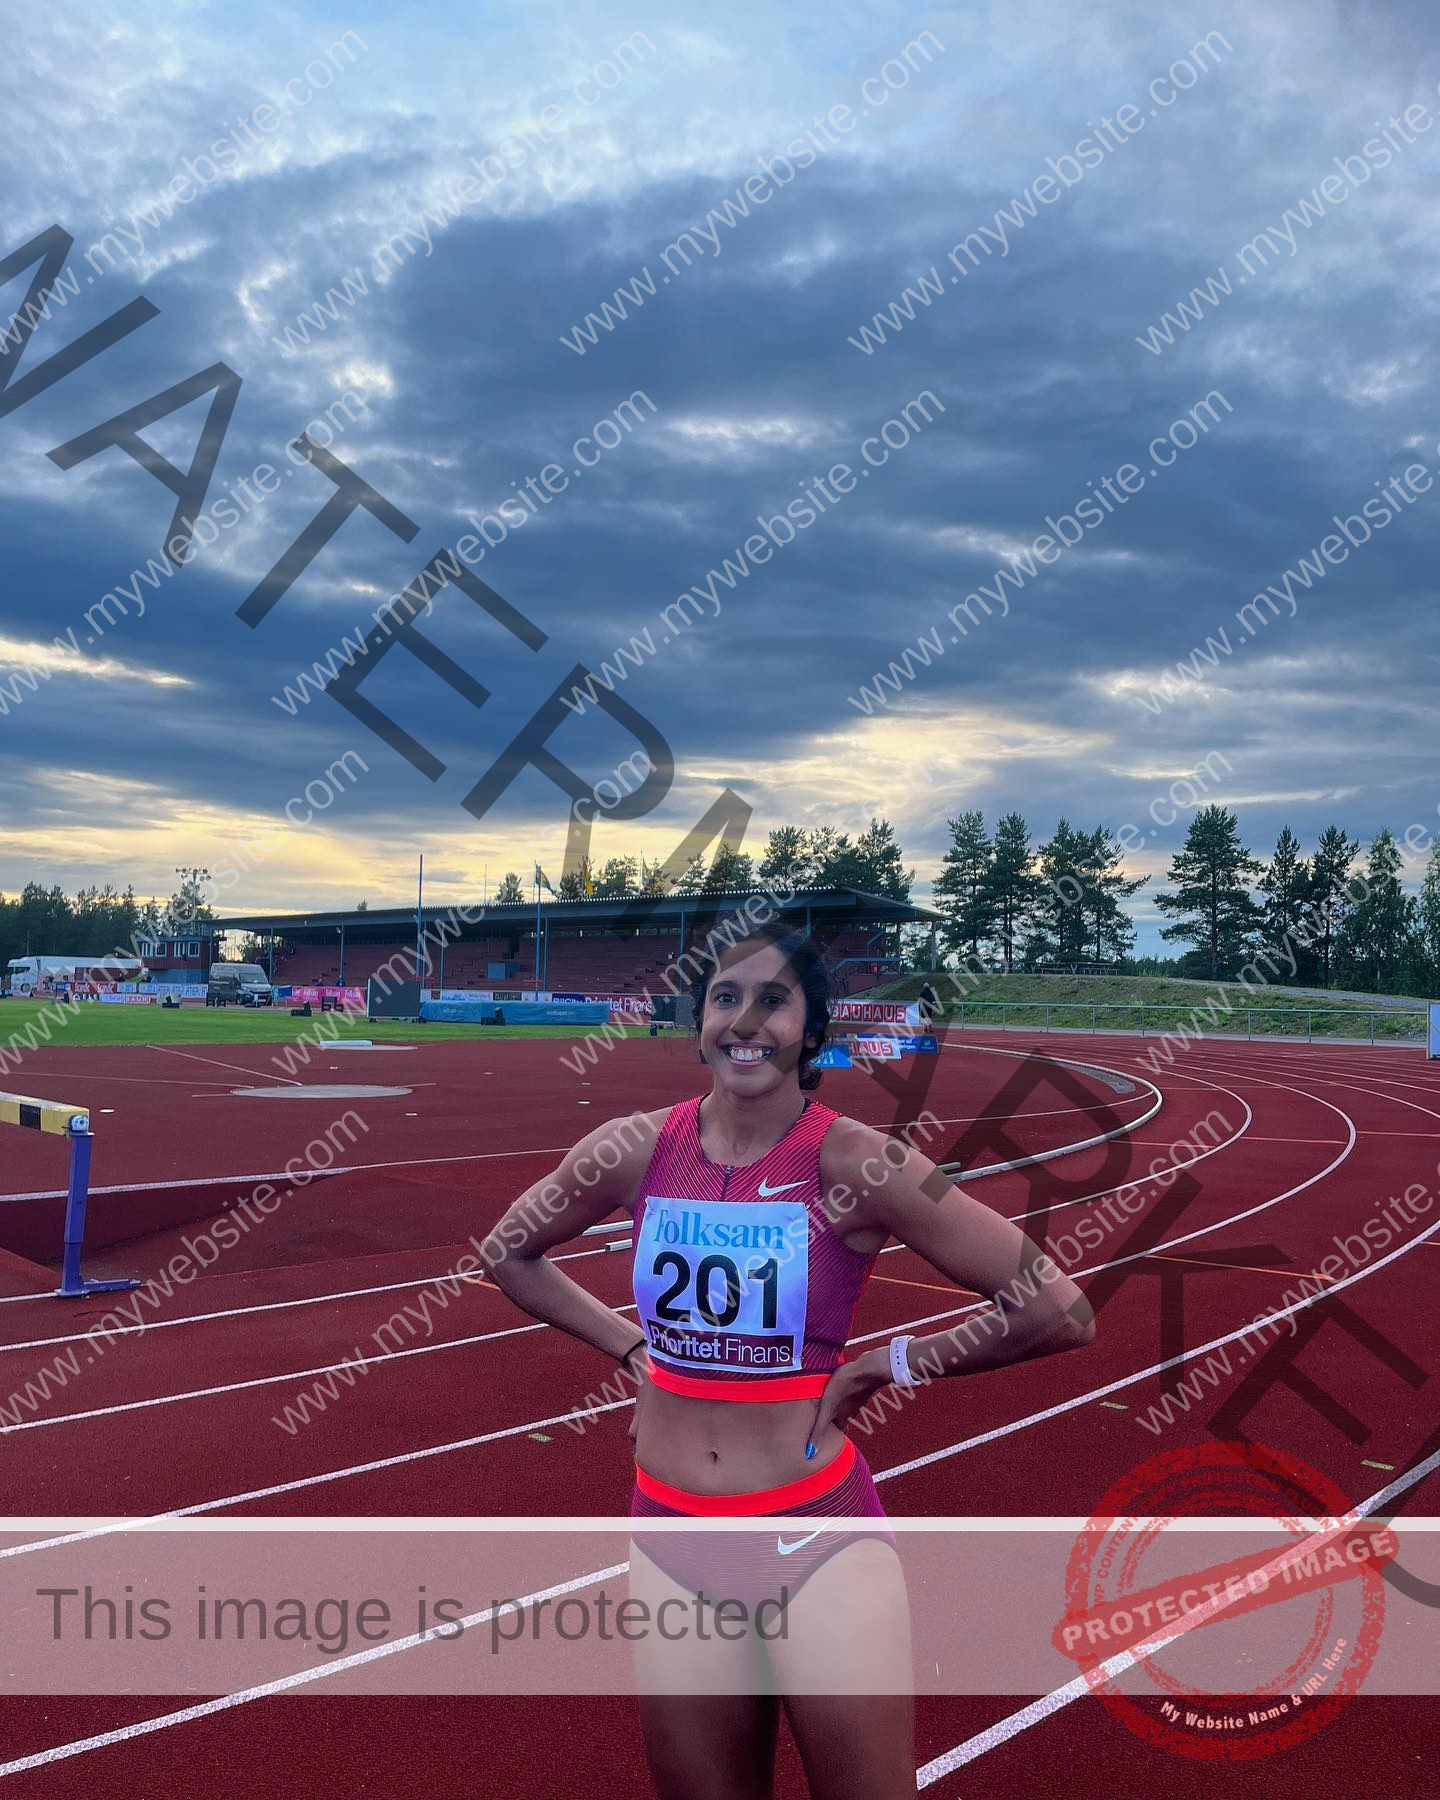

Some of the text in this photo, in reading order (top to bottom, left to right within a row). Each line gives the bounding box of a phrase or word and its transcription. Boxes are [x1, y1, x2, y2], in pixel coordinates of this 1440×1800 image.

[832, 1004, 906, 1020] BAUHAUS
[848, 1040, 892, 1055] HAUS
[652, 1250, 781, 1329] 201
[650, 1324, 791, 1364] Prioritet Finans
